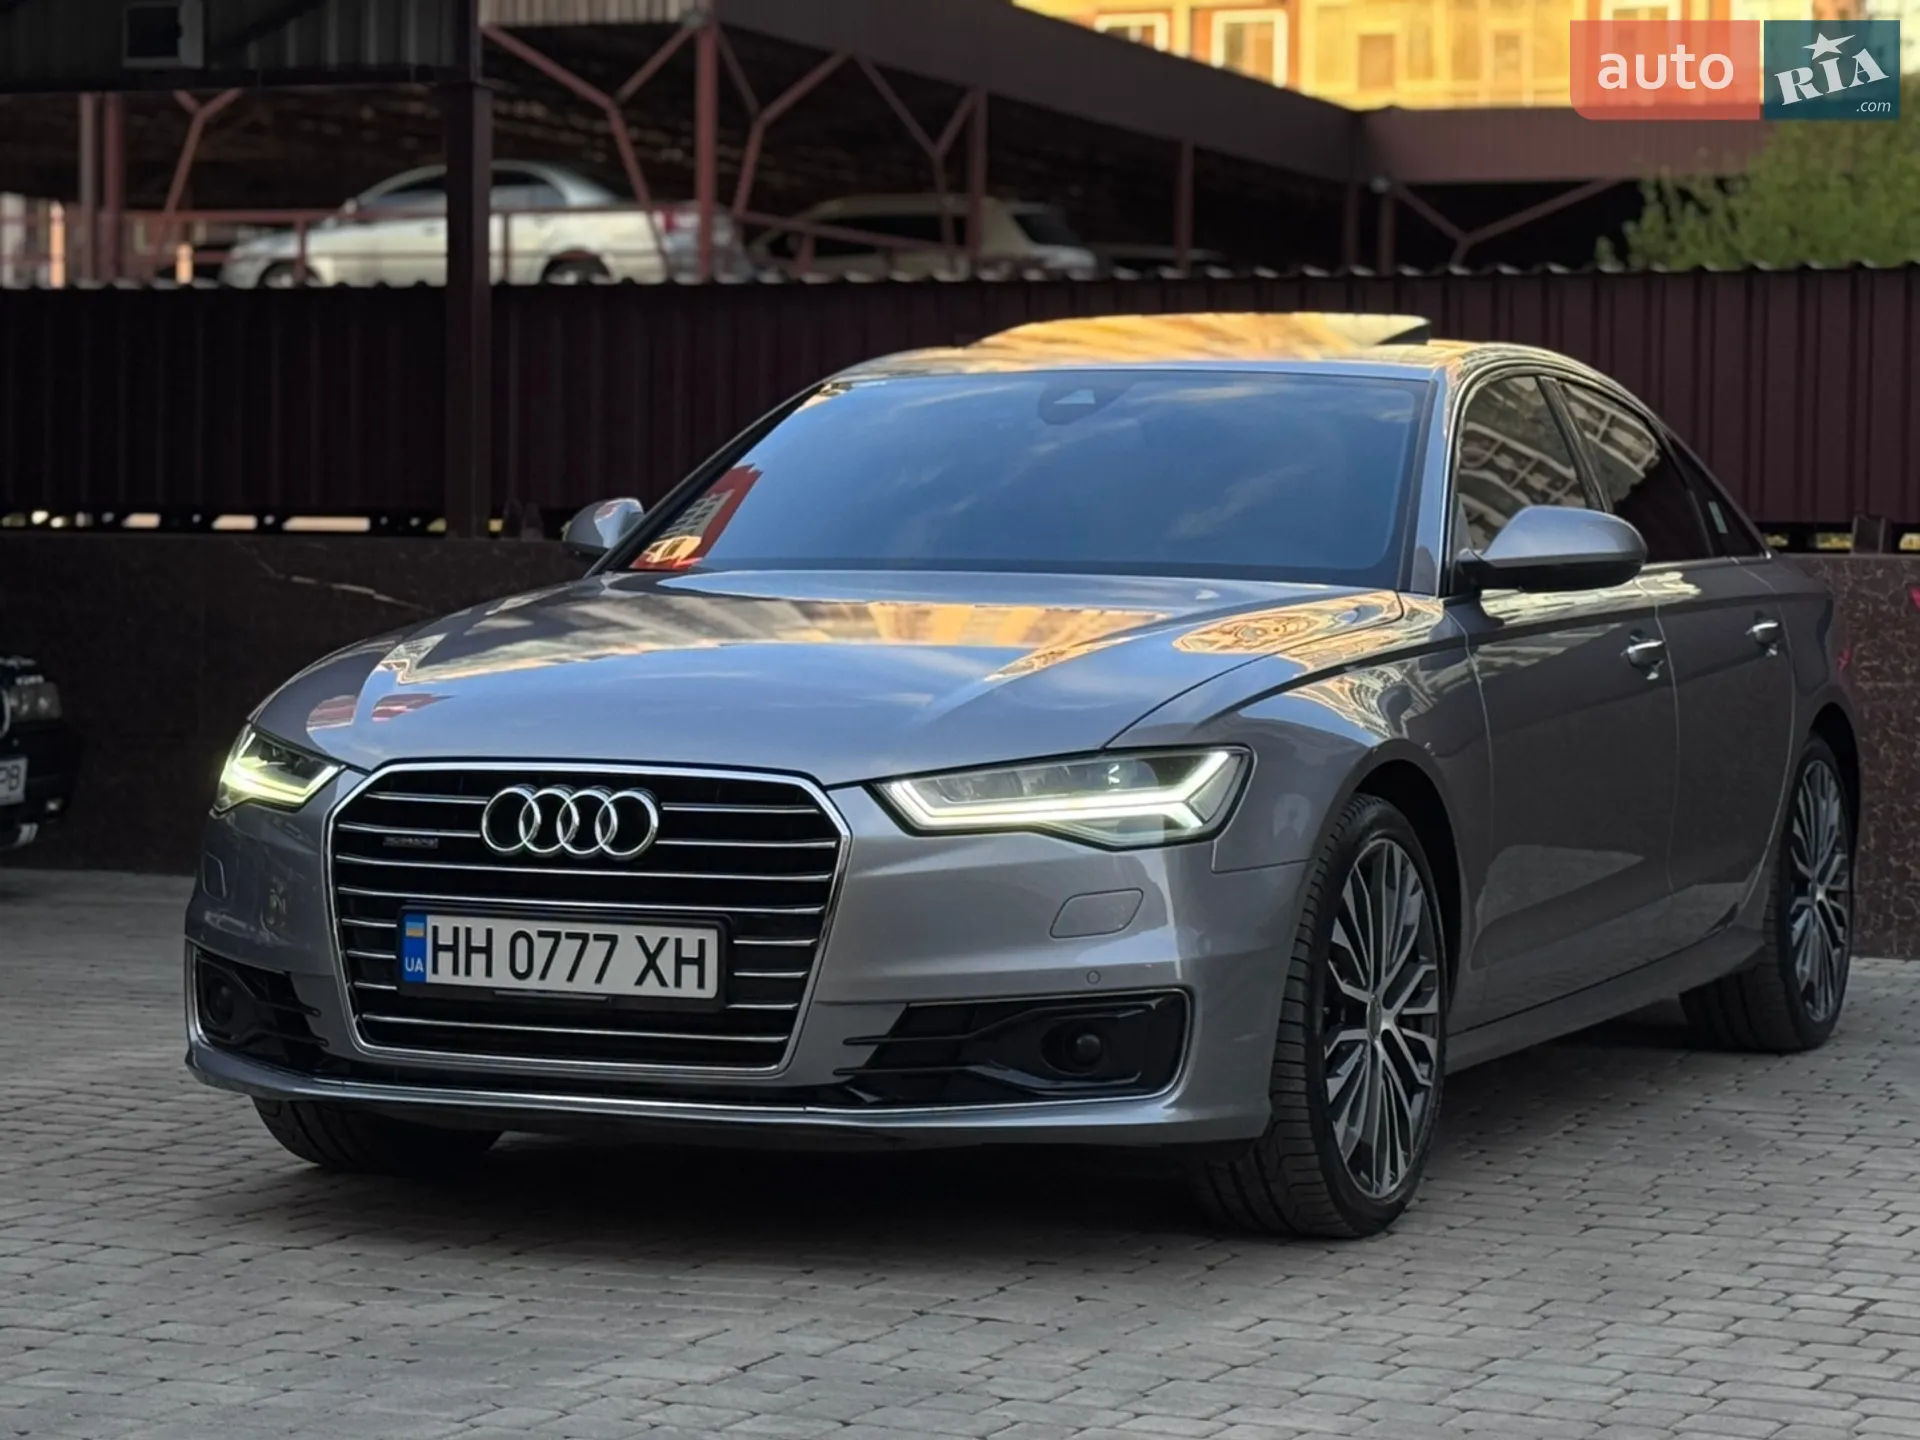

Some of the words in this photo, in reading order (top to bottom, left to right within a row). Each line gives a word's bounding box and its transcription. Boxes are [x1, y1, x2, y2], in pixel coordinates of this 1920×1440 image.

[405, 957, 424, 973] UA
[431, 925, 493, 978] HH
[509, 930, 618, 985] 0777
[634, 935, 706, 990] XH
